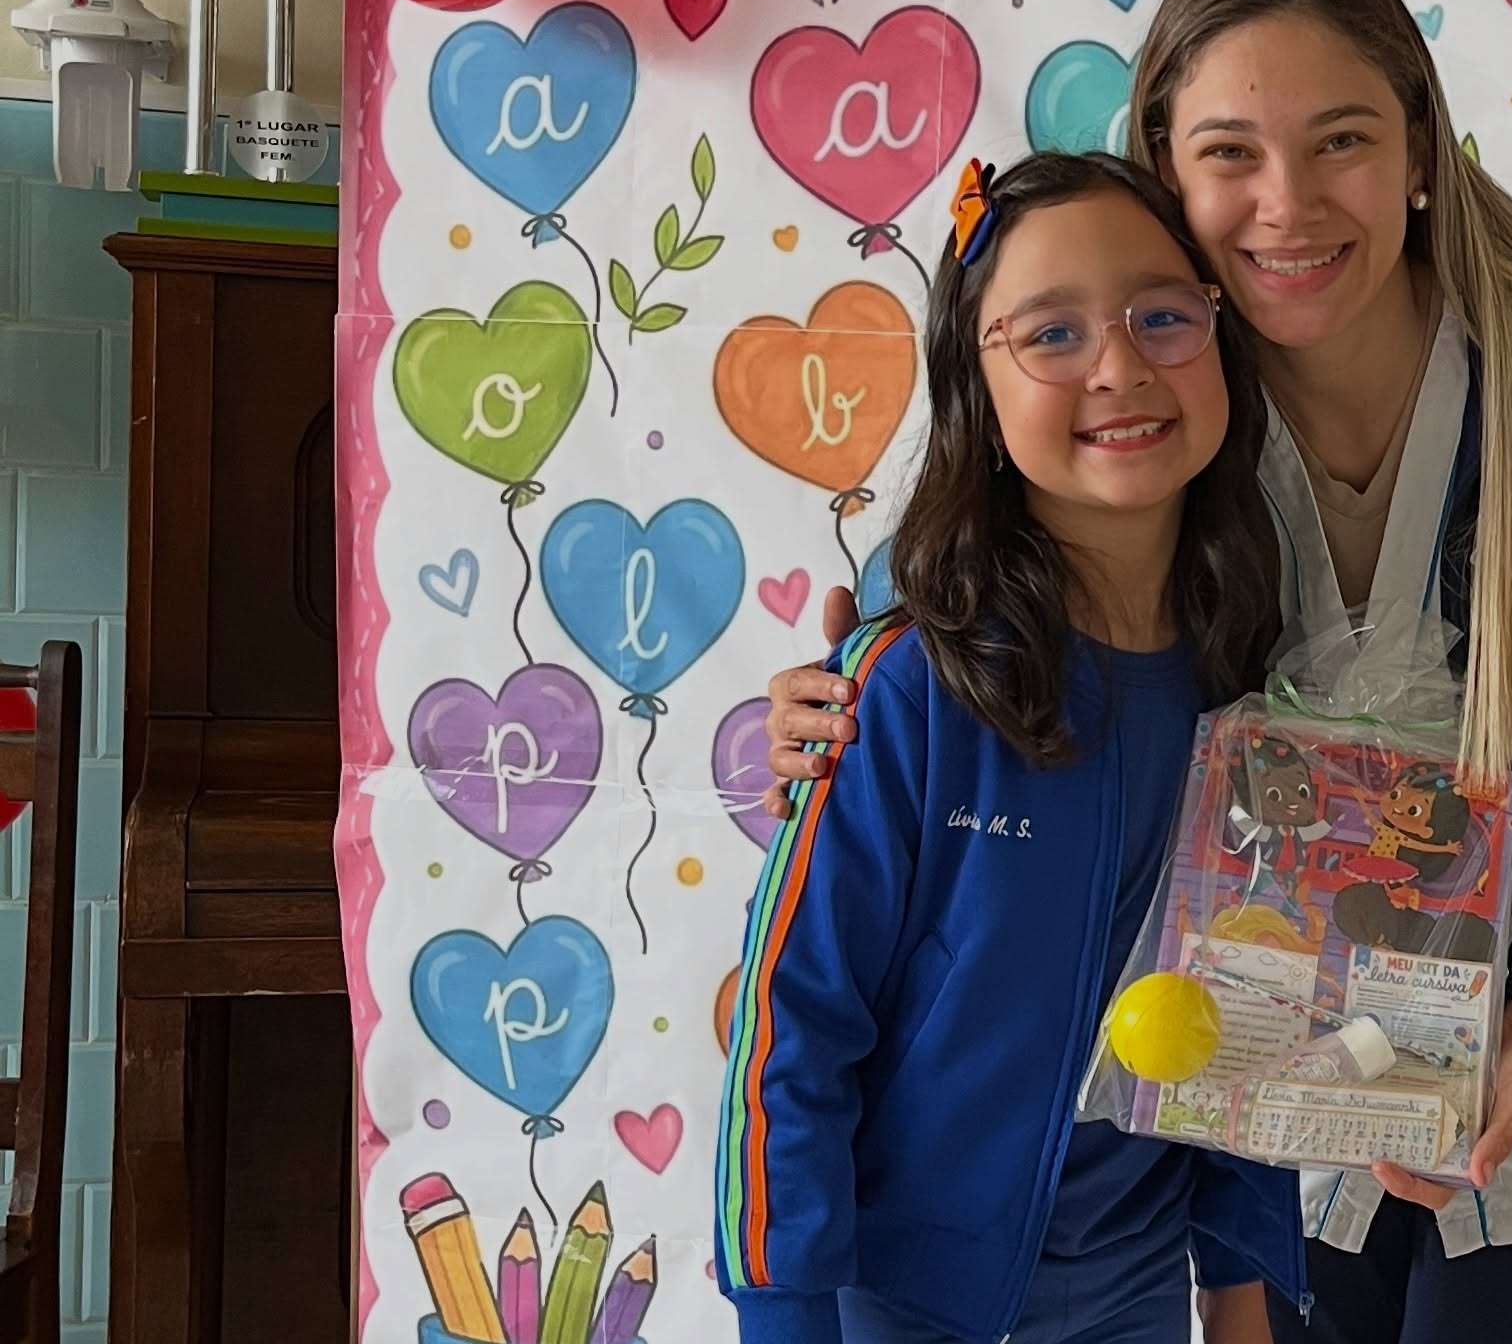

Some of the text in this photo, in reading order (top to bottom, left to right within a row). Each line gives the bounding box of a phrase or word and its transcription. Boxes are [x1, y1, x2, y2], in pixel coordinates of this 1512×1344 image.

[236, 136, 320, 148] BASQUETE
[257, 121, 319, 133] LUGAR
[486, 73, 589, 155] a
[814, 80, 926, 161] a
[462, 373, 541, 441] o
[801, 355, 865, 450] b
[617, 548, 668, 657] l
[478, 722, 558, 832] p
[987, 815, 1009, 836] M.
[1016, 818, 1032, 838] S.
[1365, 966, 1468, 994] letra cursiva
[1387, 957, 1460, 979] MEU KIT DA
[484, 977, 568, 1090] p
